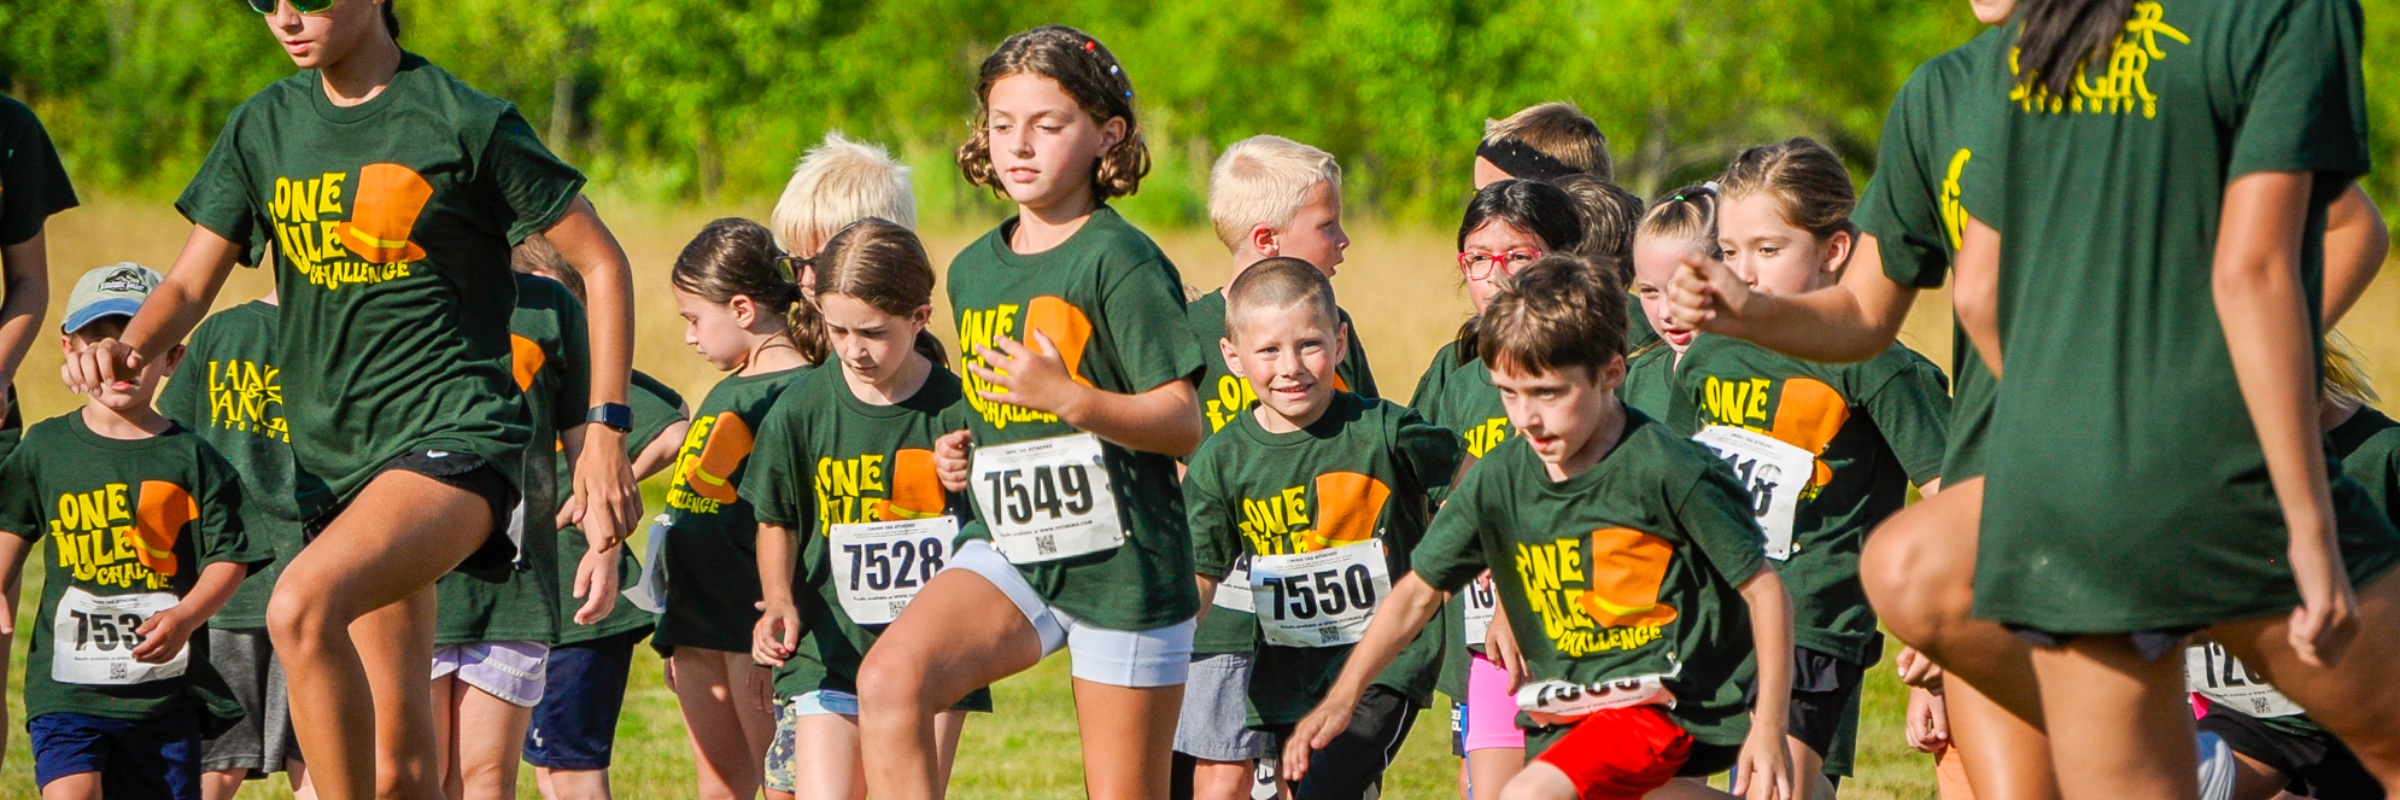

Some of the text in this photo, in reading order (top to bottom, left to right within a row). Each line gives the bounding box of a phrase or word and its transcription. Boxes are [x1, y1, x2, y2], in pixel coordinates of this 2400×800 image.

[274, 171, 347, 223] ONE
[310, 258, 410, 290] CHALLENGE
[961, 303, 1019, 356] ONE
[1218, 374, 1259, 412] ON
[1705, 376, 1771, 425] ONE
[1464, 416, 1508, 459] NE
[59, 483, 131, 531] ONE
[984, 460, 1094, 526] 7549
[1243, 485, 1310, 538] ONE
[50, 519, 137, 581] MILE
[843, 537, 944, 591] 7528
[1263, 563, 1376, 621] 7550
[70, 609, 158, 652] 753
[1556, 621, 1663, 658] CHALLENGE
